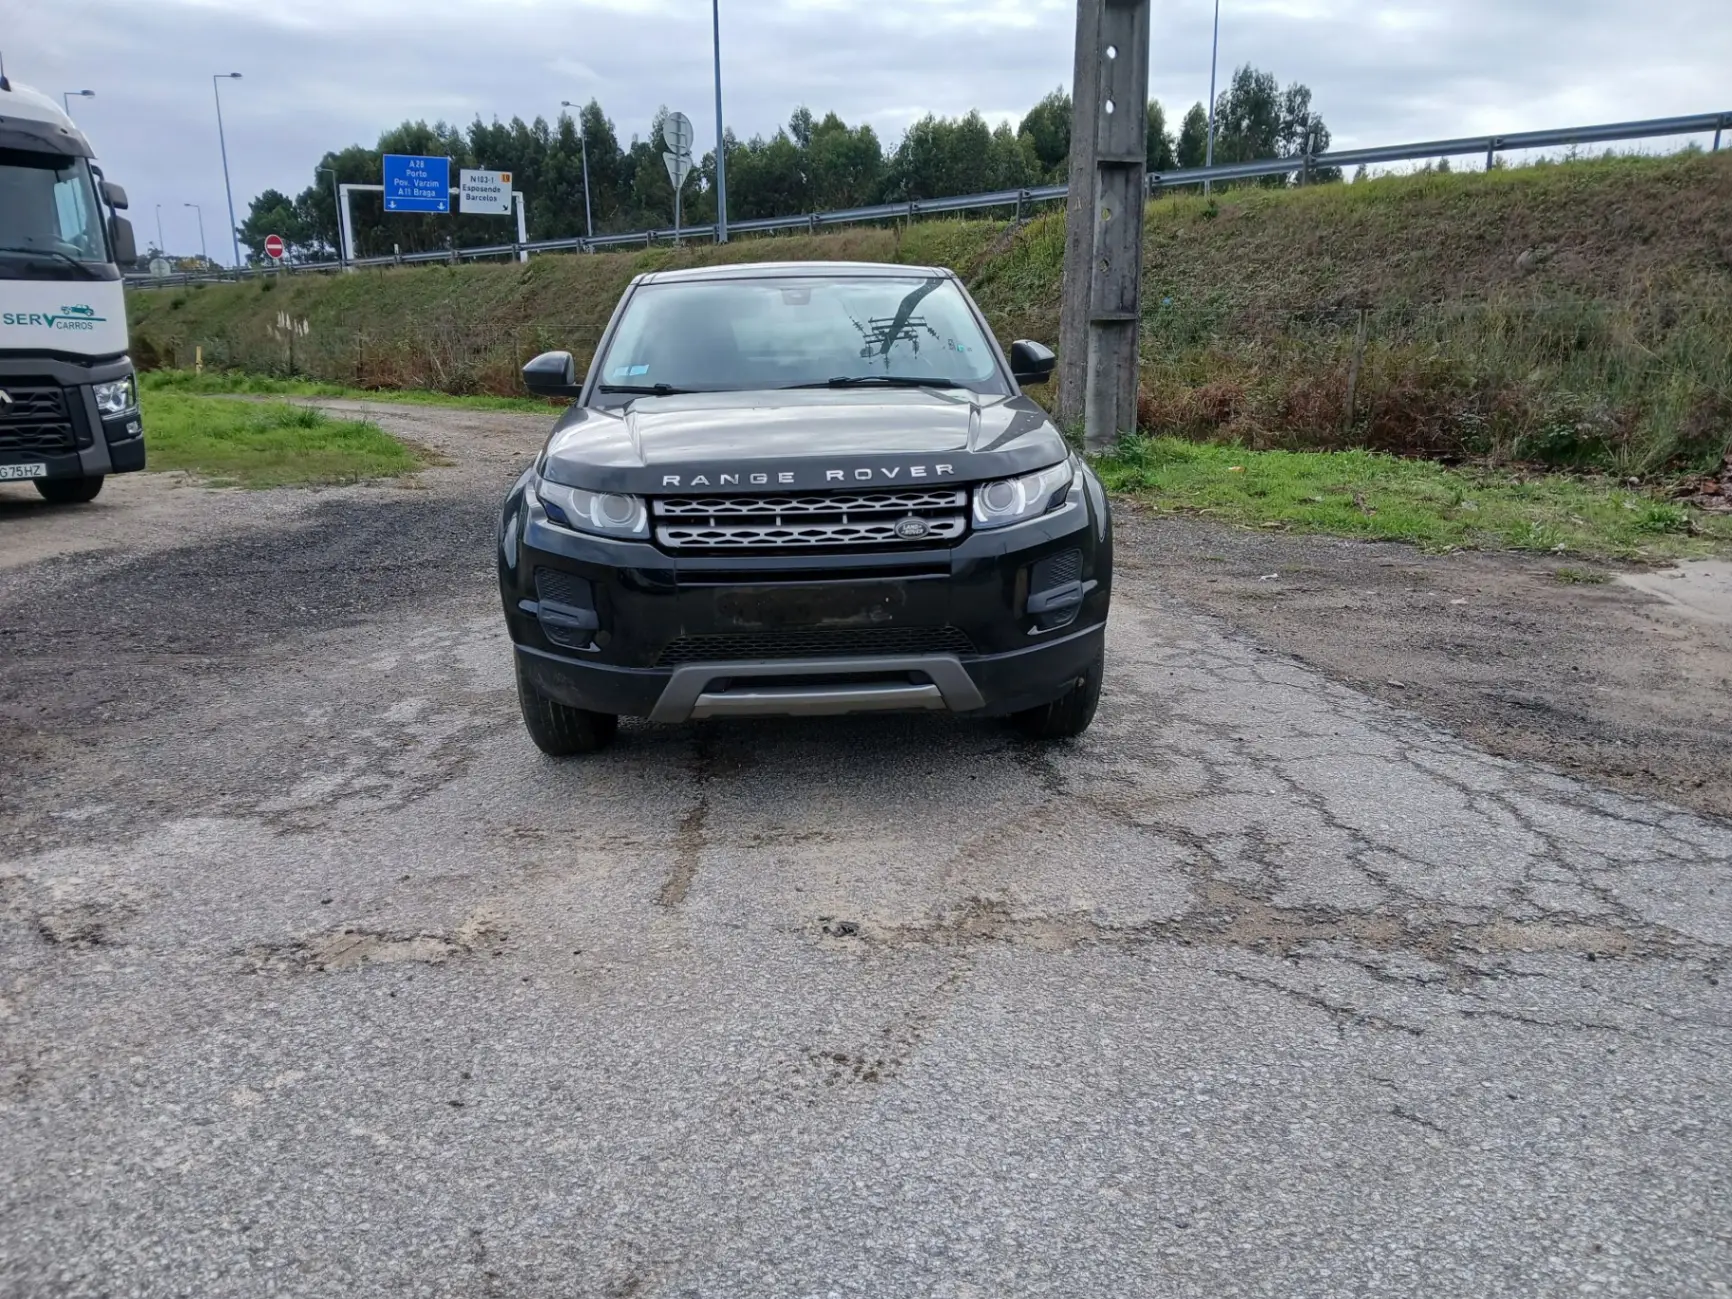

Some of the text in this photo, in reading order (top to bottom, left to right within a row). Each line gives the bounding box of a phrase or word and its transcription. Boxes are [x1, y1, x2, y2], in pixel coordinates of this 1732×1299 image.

[409, 159, 425, 168] A28
[406, 169, 428, 178] Porto
[394, 178, 440, 188] Pov. Varzim
[470, 175, 494, 184] N103-1
[398, 187, 436, 198] A11 Braga
[462, 184, 502, 193] Esposende
[465, 193, 498, 202] Barcelos
[56, 321, 93, 331] CARROS
[662, 463, 956, 487] RANGE ROVER
